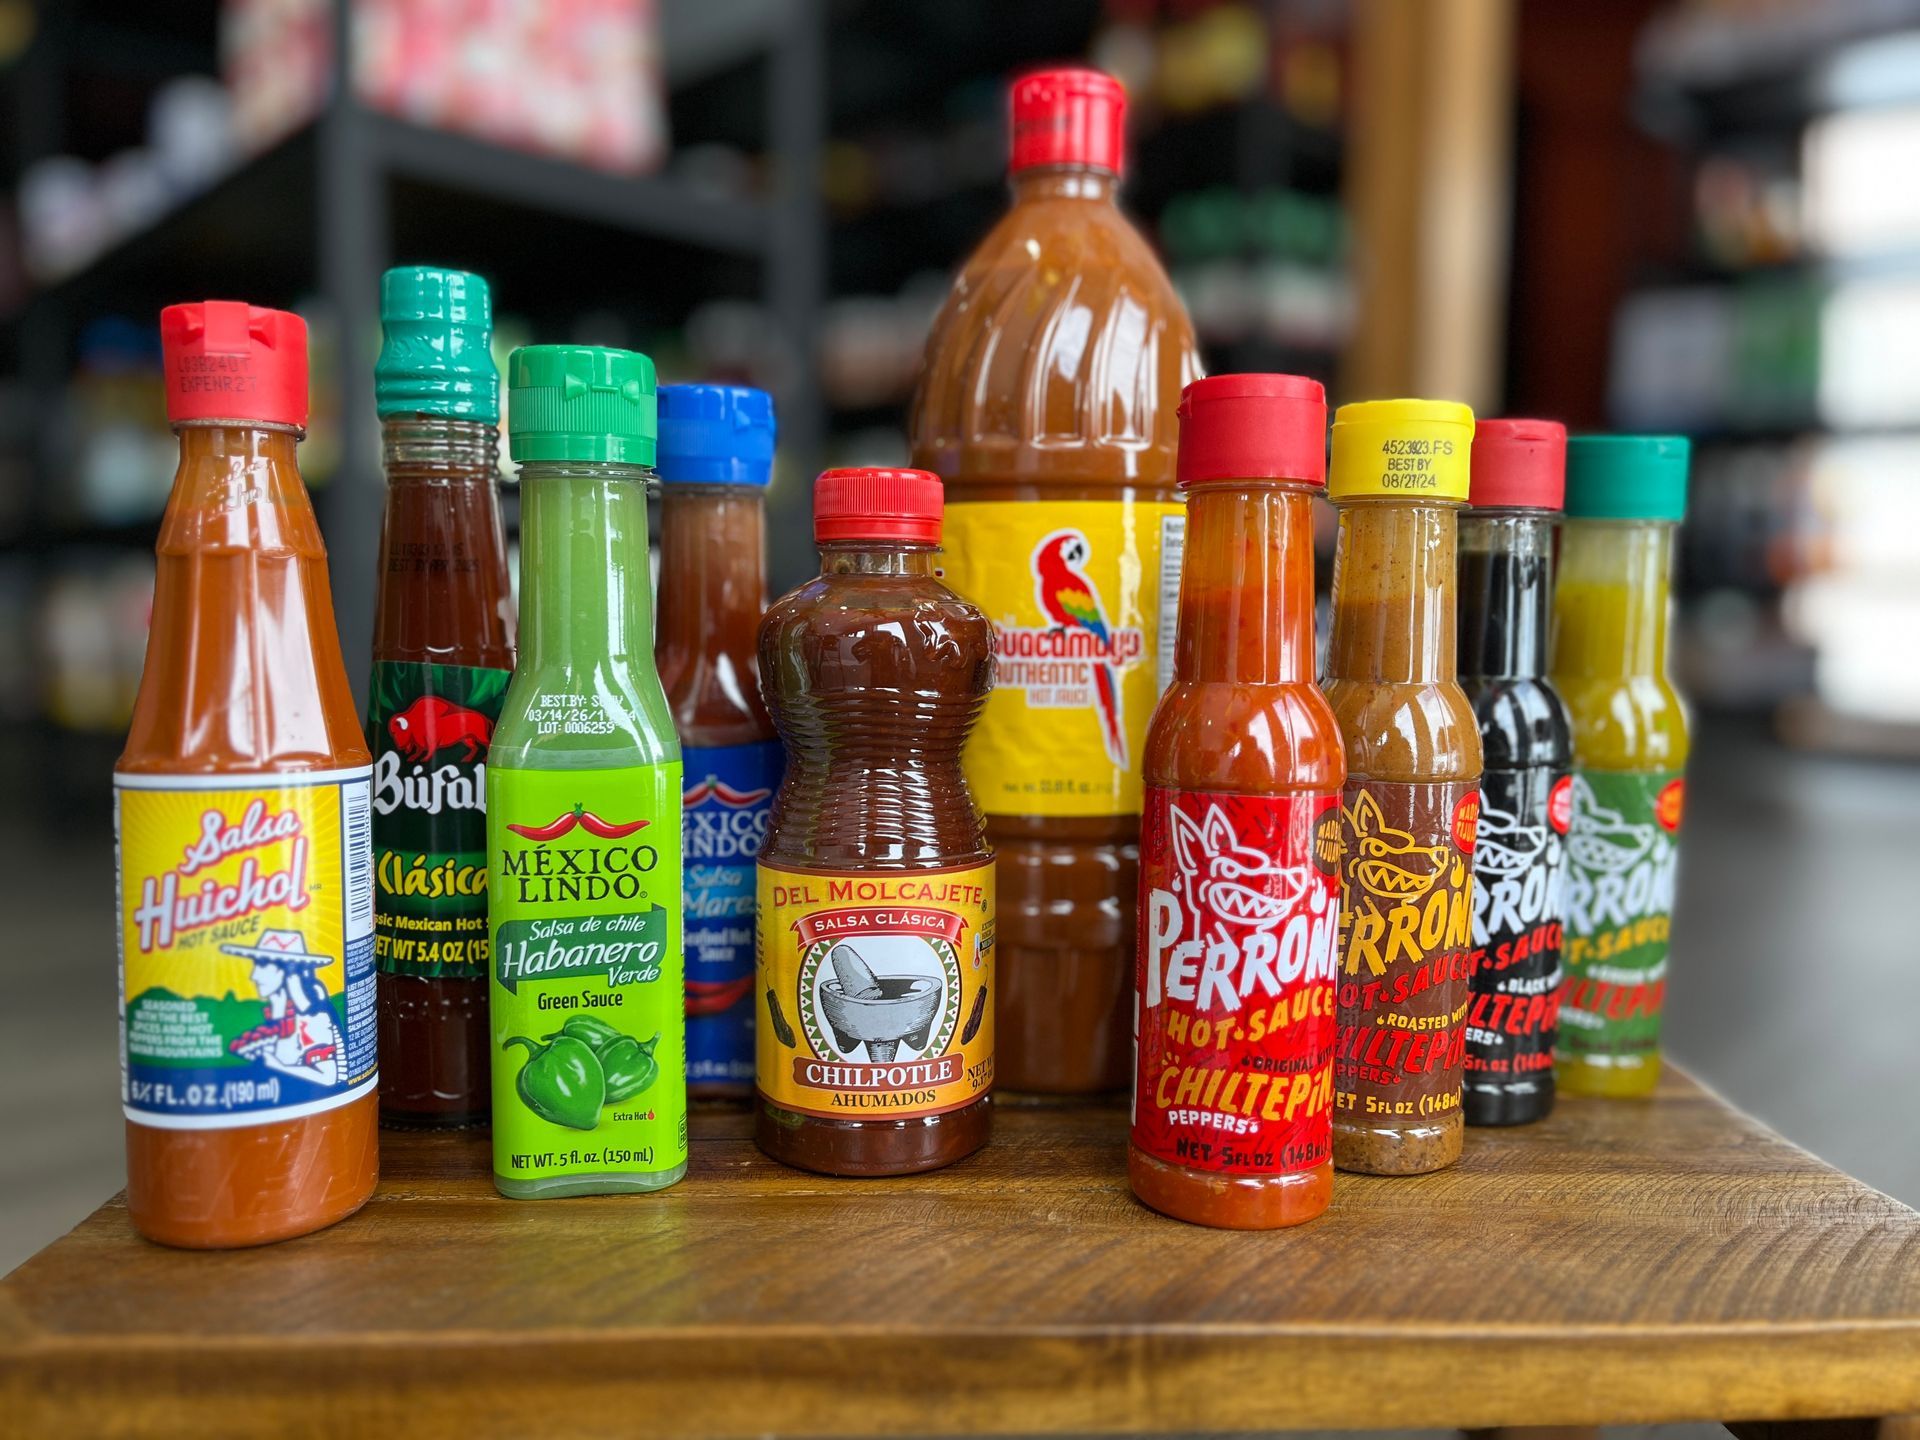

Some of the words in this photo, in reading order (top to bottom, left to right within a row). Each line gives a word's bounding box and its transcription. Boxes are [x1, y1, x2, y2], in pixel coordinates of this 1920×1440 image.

[1388, 458, 1415, 471] BEST
[1417, 458, 1432, 471] BY
[540, 694, 567, 708] BEST
[537, 721, 562, 734] LOT:
[564, 721, 616, 734] 0006259
[373, 750, 487, 815] Búfal
[178, 799, 300, 874] Salsa
[683, 830, 762, 858] INDO
[501, 844, 658, 876] MÉXICO
[517, 873, 640, 903] LINDO
[687, 864, 743, 889] Salsa
[134, 836, 309, 955] Huichol
[773, 884, 819, 907] DEL
[828, 880, 984, 906] MOLCAJETE
[177, 929, 212, 950] HOT
[210, 915, 261, 944] SAUCE
[395, 915, 452, 931] Mexican
[456, 918, 483, 930] Hot
[529, 920, 575, 941] Salsa
[579, 917, 602, 932] de
[605, 915, 647, 932] chile
[814, 914, 870, 932] SALSA
[875, 911, 946, 930] CLÁSICA
[375, 935, 392, 957] ET
[393, 938, 416, 960] WT
[417, 941, 440, 962] 5.4
[442, 941, 465, 962] OZ
[467, 939, 489, 964] (15
[503, 939, 659, 978] Habanero
[1146, 887, 1340, 1012] PERRON
[608, 965, 660, 987] Verde
[537, 993, 579, 1010] Green
[581, 990, 623, 1008] Sauce
[1338, 981, 1383, 1011] OT
[1168, 1009, 1237, 1050] HOT
[1248, 985, 1333, 1042] SAUCE
[1387, 1012, 1449, 1032] ROASTED
[804, 1059, 953, 1088] CHILPOTLE
[1253, 1055, 1314, 1073] ORIGINAL
[1336, 1064, 1393, 1085] PPERS
[830, 1089, 937, 1108] AHUMADOS
[1336, 1092, 1357, 1111] ET
[613, 1112, 633, 1121] Extra
[634, 1111, 648, 1120] Hot
[1168, 1109, 1249, 1134] PEPPERS
[511, 1154, 532, 1169] NET
[559, 1153, 568, 1167] 5
[584, 1152, 601, 1163] oz.
[602, 1147, 630, 1165] (150
[1176, 1137, 1212, 1162] NET
